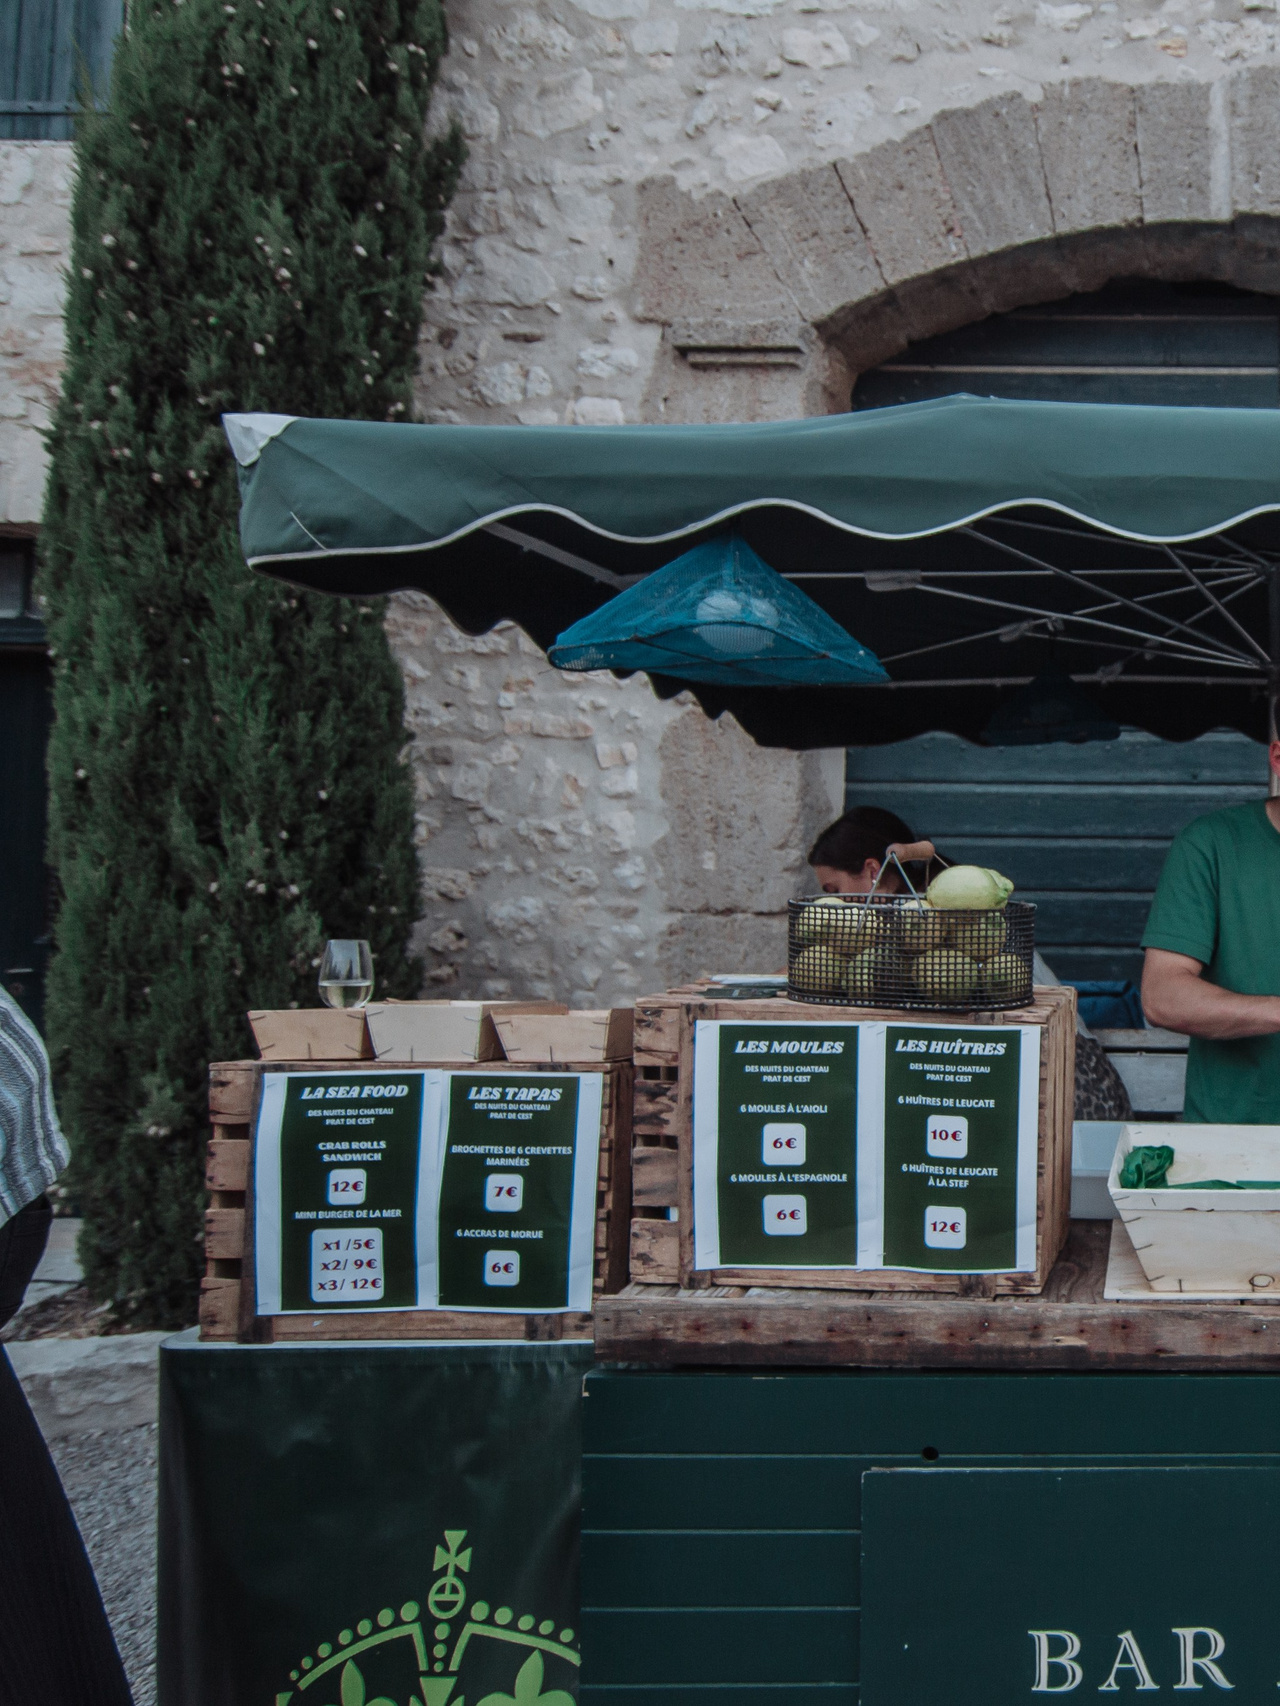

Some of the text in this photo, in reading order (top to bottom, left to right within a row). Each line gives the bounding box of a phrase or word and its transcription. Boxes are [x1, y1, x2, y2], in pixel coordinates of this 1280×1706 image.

[735, 1040, 844, 1054] LES MOULES
[895, 1038, 1007, 1055] LES HUÎTRES
[926, 1073, 943, 1081] PRAT
[301, 1085, 408, 1099] LA SEA FOOD
[468, 1086, 562, 1101] LES TAPAS
[898, 1094, 995, 1108] 6 HUÎTRES DE LEUCATE
[740, 1103, 827, 1113] 6 MOULES À L'AIOLI
[931, 1129, 962, 1141] 10€
[317, 1141, 387, 1150] CRAB ROLLS
[451, 1145, 503, 1154] BROCHETTES
[504, 1146, 516, 1154] DE
[322, 1153, 382, 1162] SANDWICH
[486, 1156, 530, 1166] MARINÉES
[901, 1163, 998, 1176] 6 HUÎTRES DE LEUCATE
[730, 1172, 847, 1182] 6 MOULES À L'ESPAGNOLE
[928, 1176, 969, 1188] À LA STEF
[332, 1181, 364, 1192] 12€
[494, 1186, 518, 1197] 7€
[295, 1211, 317, 1219] MINI
[318, 1210, 354, 1218] BURGER
[355, 1210, 367, 1218] DE
[382, 1209, 402, 1217] MER
[930, 1221, 961, 1233] 12€
[456, 1229, 462, 1237] 6
[464, 1229, 497, 1238] ACCRAS
[498, 1230, 509, 1238] DE
[1028, 1627, 1236, 1692] BAR
